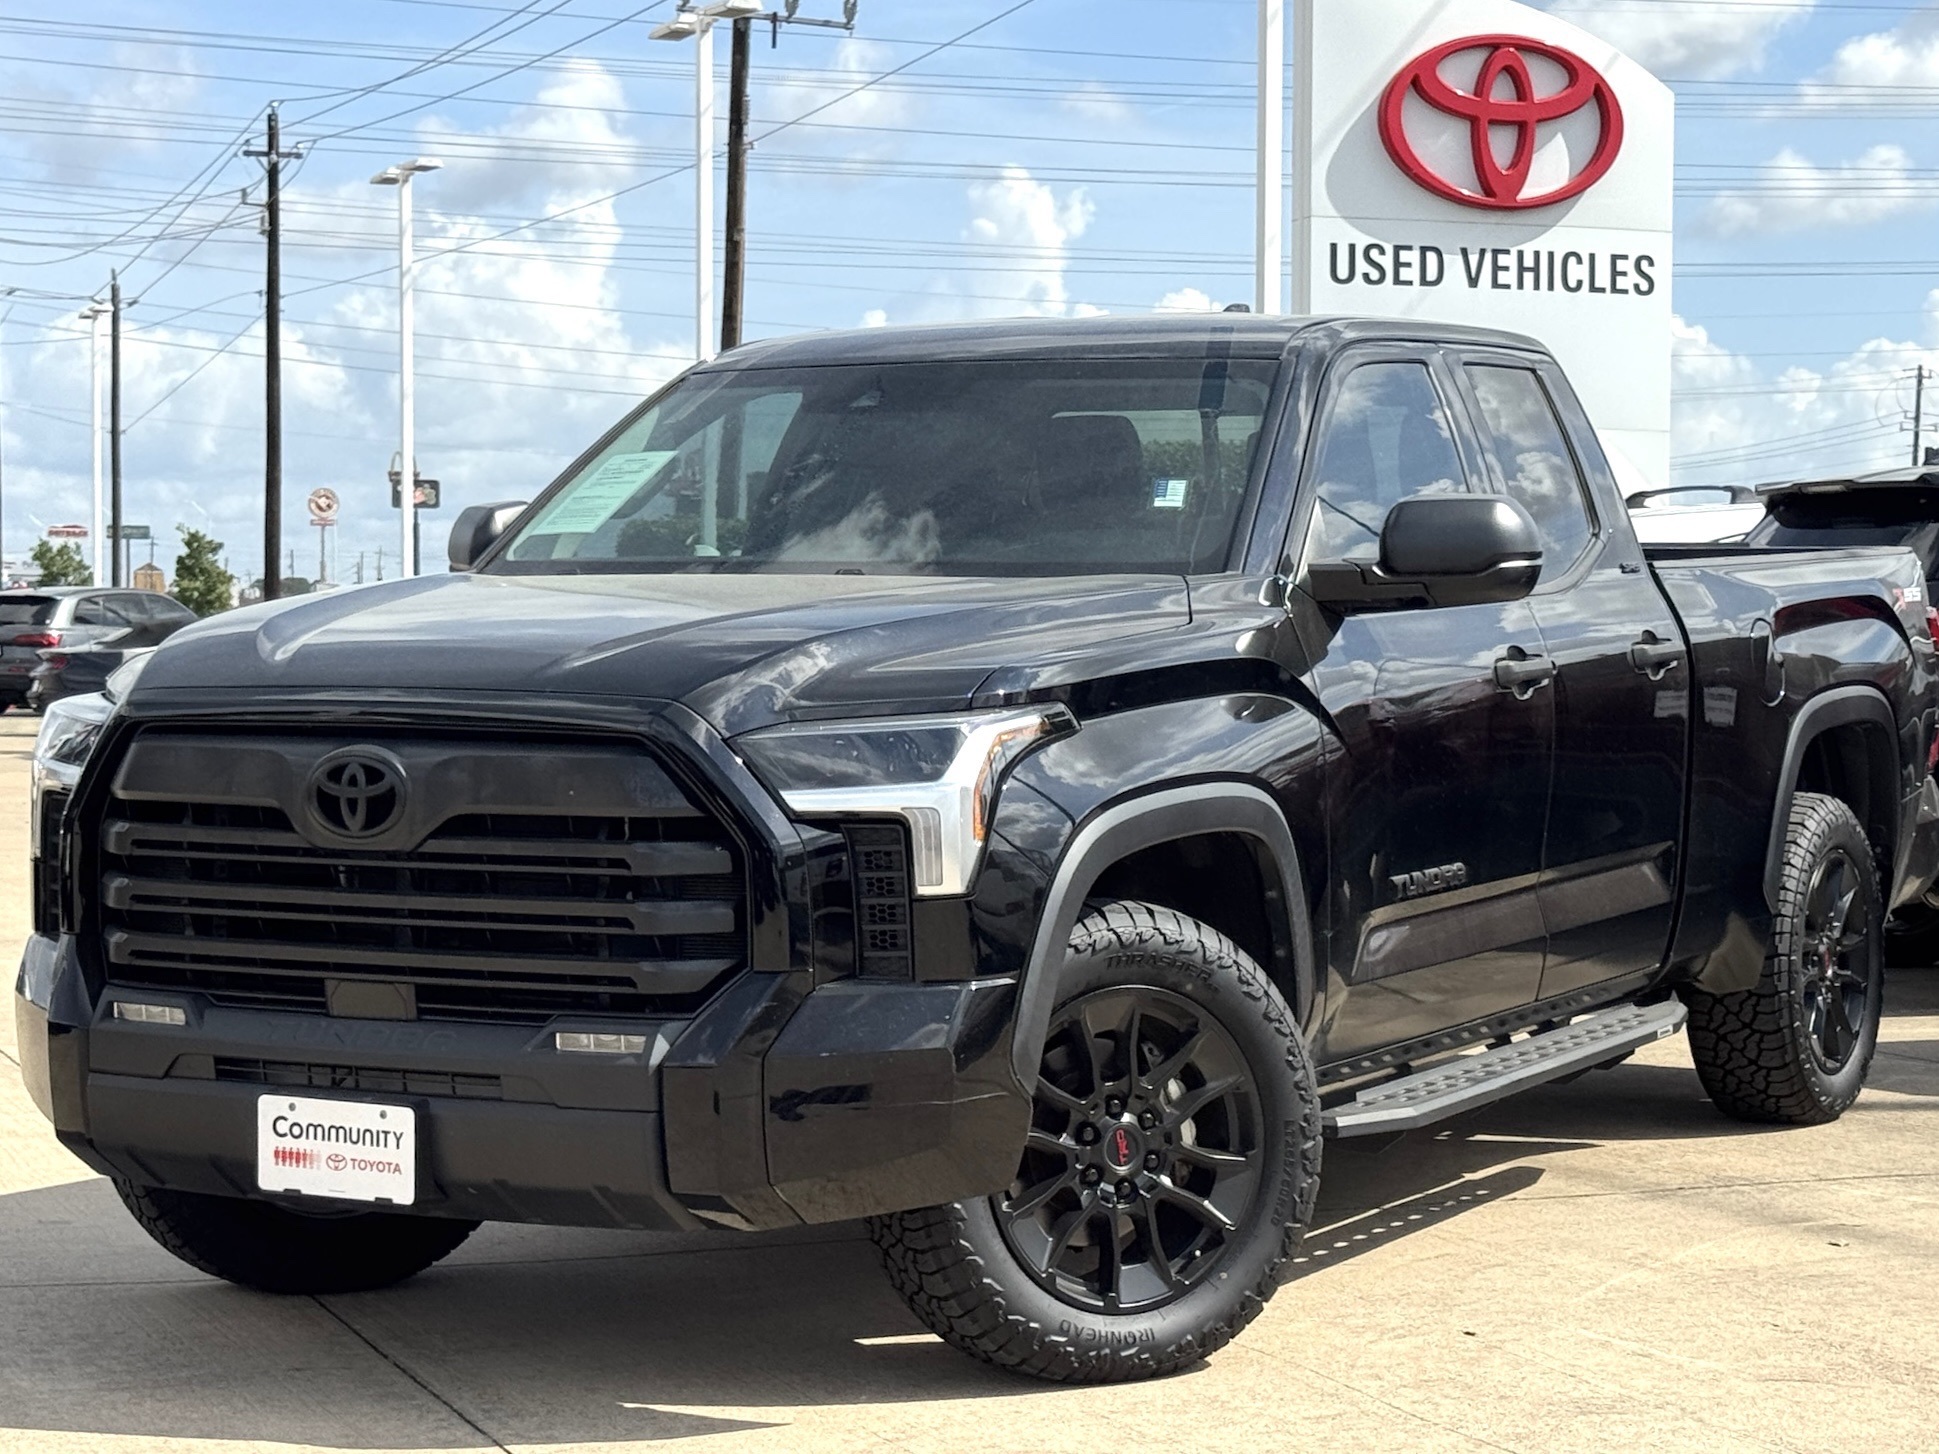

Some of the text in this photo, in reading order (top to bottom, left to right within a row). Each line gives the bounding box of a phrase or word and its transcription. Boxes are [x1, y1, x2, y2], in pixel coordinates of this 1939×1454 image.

[1329, 242, 1655, 296] USED VEHICLES
[1388, 862, 1466, 898] TUNDRA
[1103, 952, 1216, 983] THRASHER
[350, 1158, 403, 1175] TOYOTA
[1059, 1319, 1156, 1344] IRONHEAD
